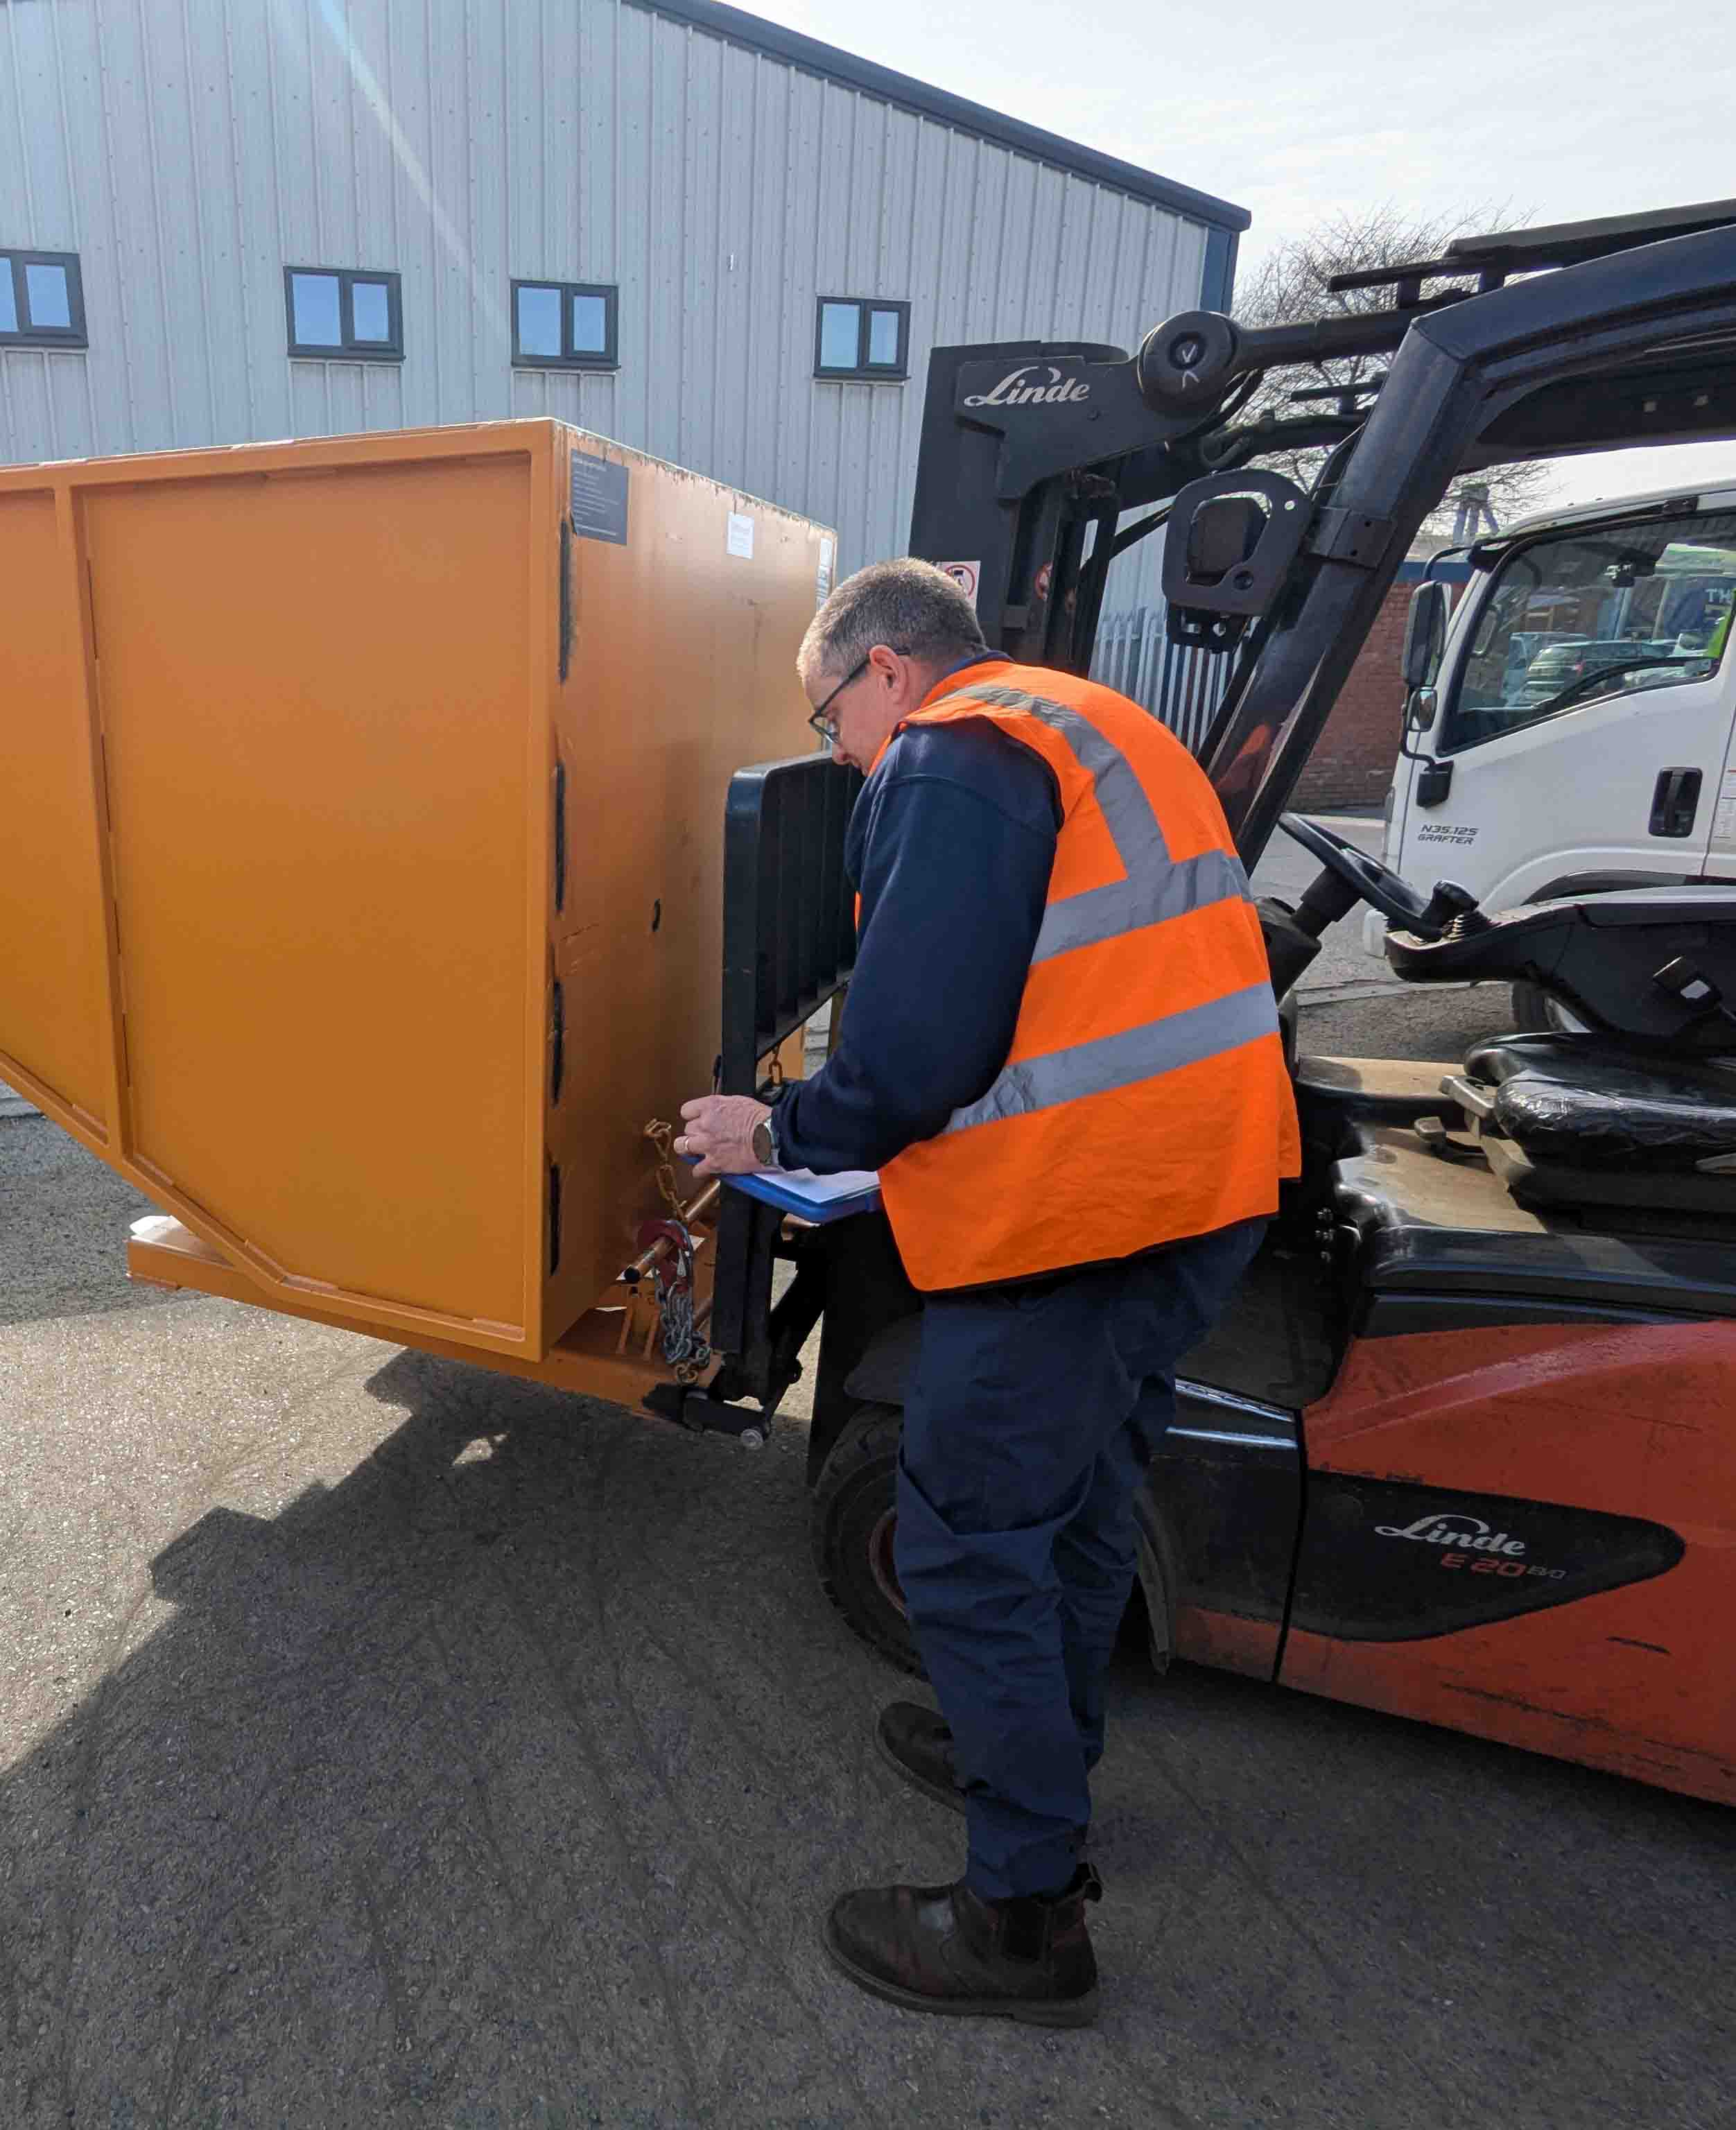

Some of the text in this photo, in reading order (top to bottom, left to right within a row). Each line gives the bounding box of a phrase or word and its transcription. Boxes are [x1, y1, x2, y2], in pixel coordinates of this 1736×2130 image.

[964, 365, 1090, 407] Linde
[1418, 833, 1475, 845] GRAFTER
[1374, 1514, 1526, 1555] Linde
